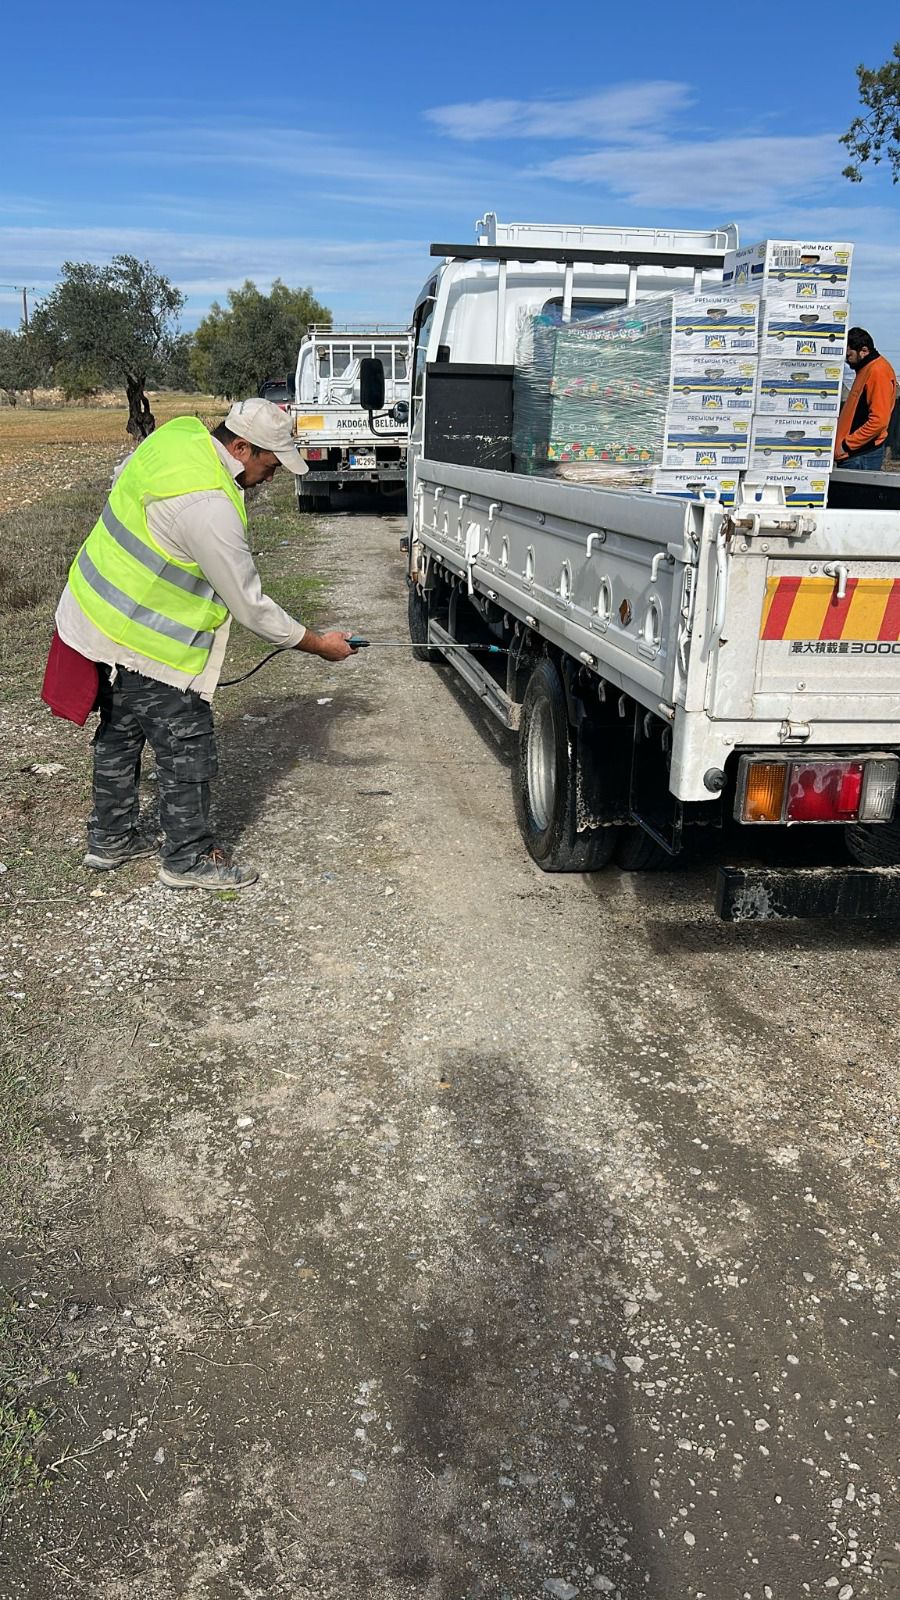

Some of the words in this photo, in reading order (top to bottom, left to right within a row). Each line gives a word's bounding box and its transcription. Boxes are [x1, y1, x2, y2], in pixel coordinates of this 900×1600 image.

[796, 282, 817, 295] BONITA
[705, 335, 726, 346] BONITA
[796, 340, 816, 352] BONITA
[702, 394, 722, 406] BONITA
[788, 398, 808, 408] BONITA
[696, 452, 716, 462] BONITA
[782, 454, 802, 466] BONITA
